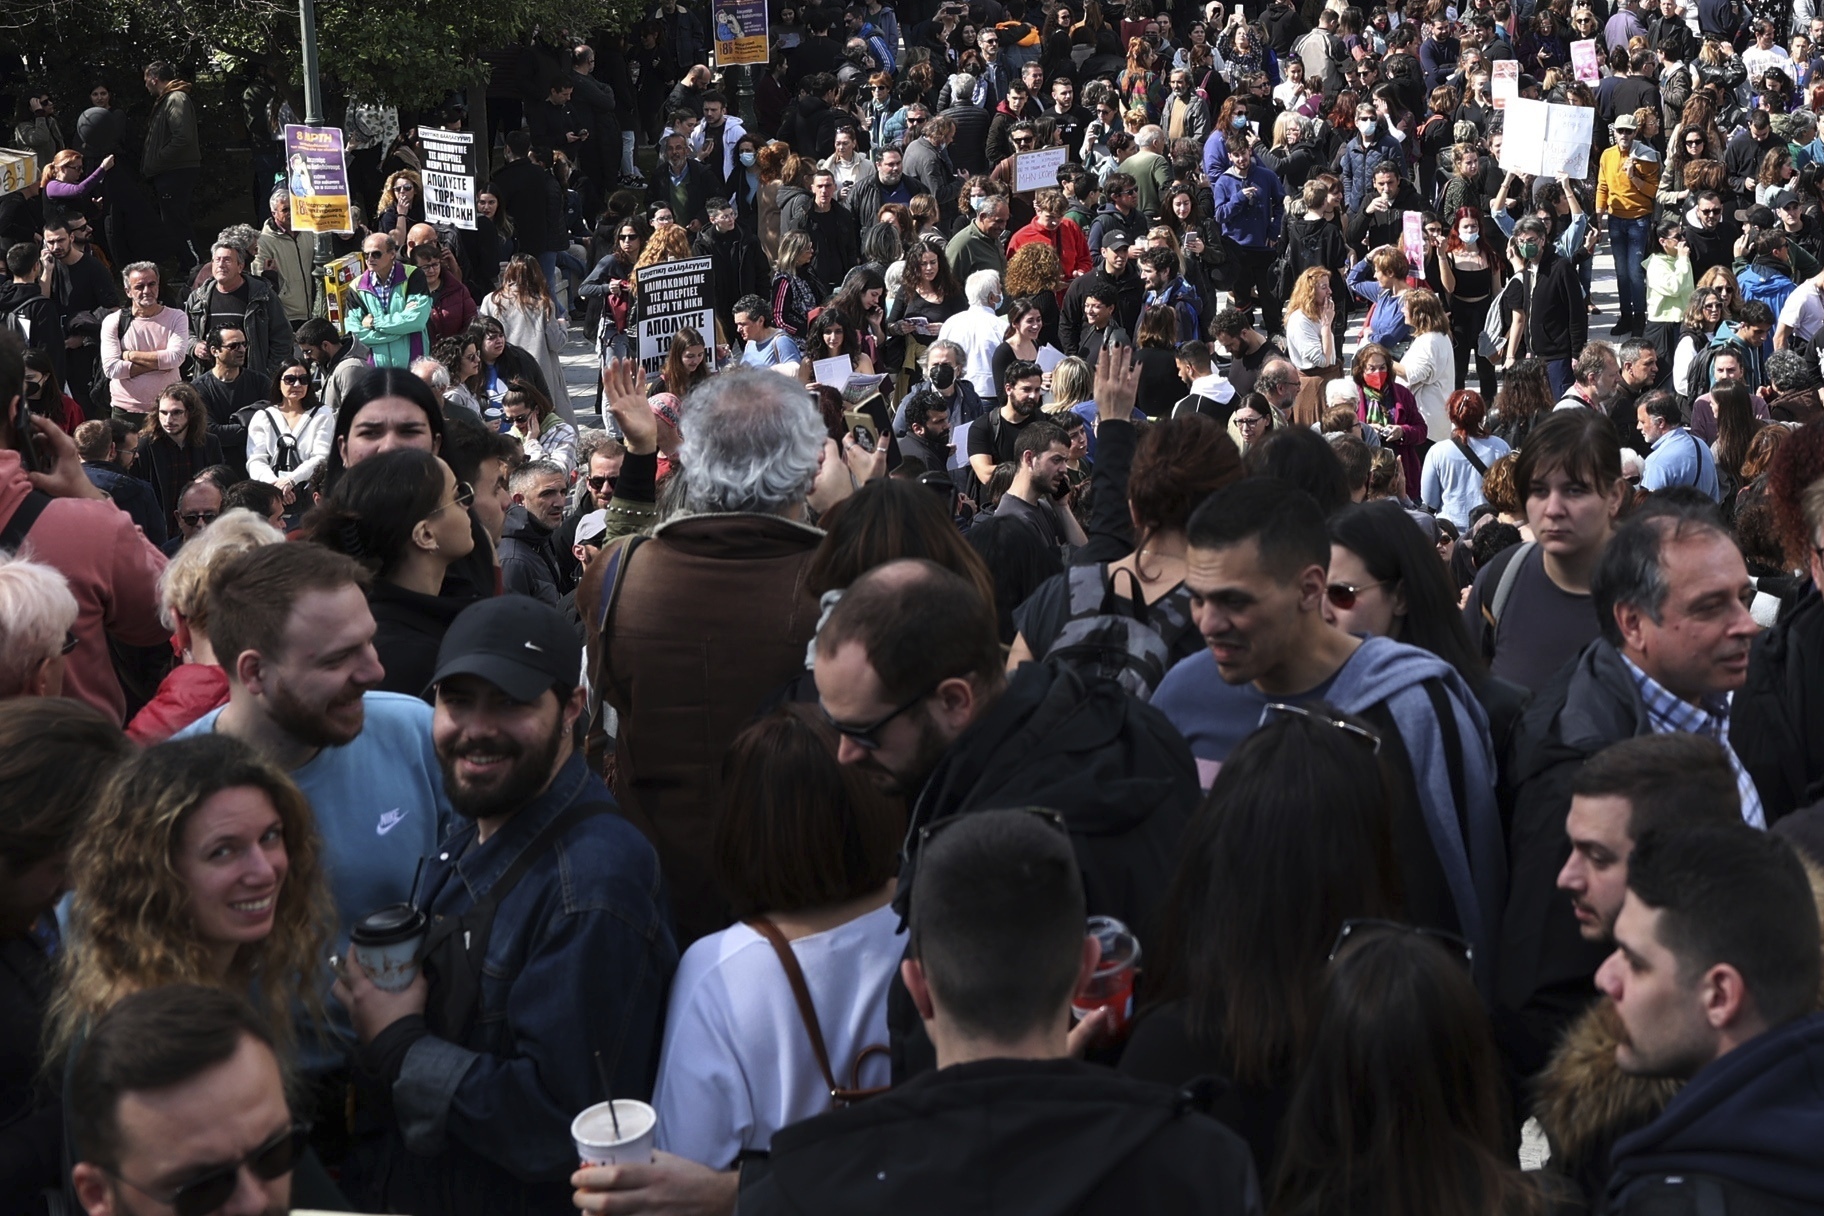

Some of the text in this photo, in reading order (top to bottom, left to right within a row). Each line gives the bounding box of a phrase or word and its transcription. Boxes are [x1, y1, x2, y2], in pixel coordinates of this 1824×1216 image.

[296, 131, 303, 140] 8
[427, 173, 467, 191] ΑΠΟΛΥΣΤΕ
[434, 189, 455, 204] ΤΩΡΑ
[426, 201, 473, 221] ΜΗΤΣΟΤΑΚΗ
[644, 273, 705, 293] ΚΛΙΜΑΚΩΝΟΥΜΕ
[650, 286, 698, 303] ΤΙΣ ΑΠΕΡΓΙΕΣ
[647, 297, 703, 316] ΜΕΧΡΙ ΤΗ ΝΙΚΗ
[646, 312, 704, 337] ΑΠΟΛΥΣΤΕ
